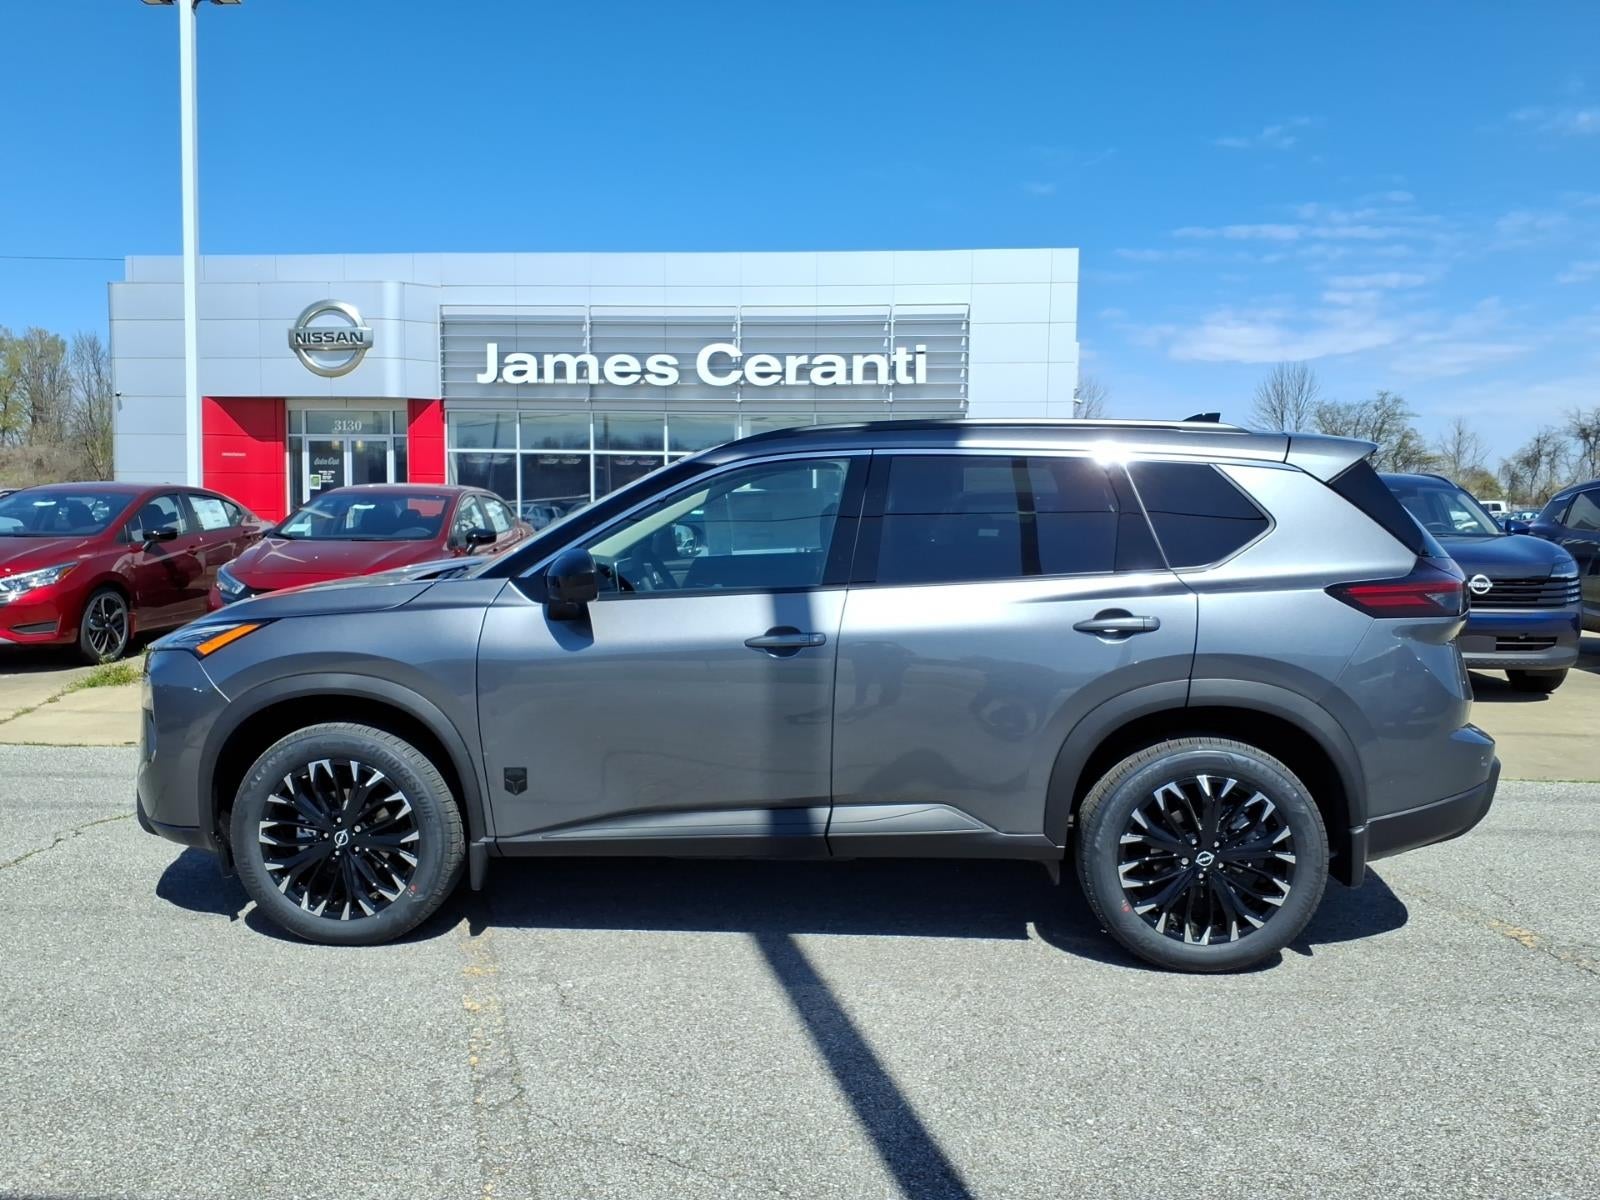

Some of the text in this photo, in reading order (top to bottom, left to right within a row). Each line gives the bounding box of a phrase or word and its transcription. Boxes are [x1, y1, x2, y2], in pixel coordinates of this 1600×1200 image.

[295, 332, 363, 345] NISSAN
[476, 343, 927, 386] James Ceranti
[334, 419, 362, 431] 3130
